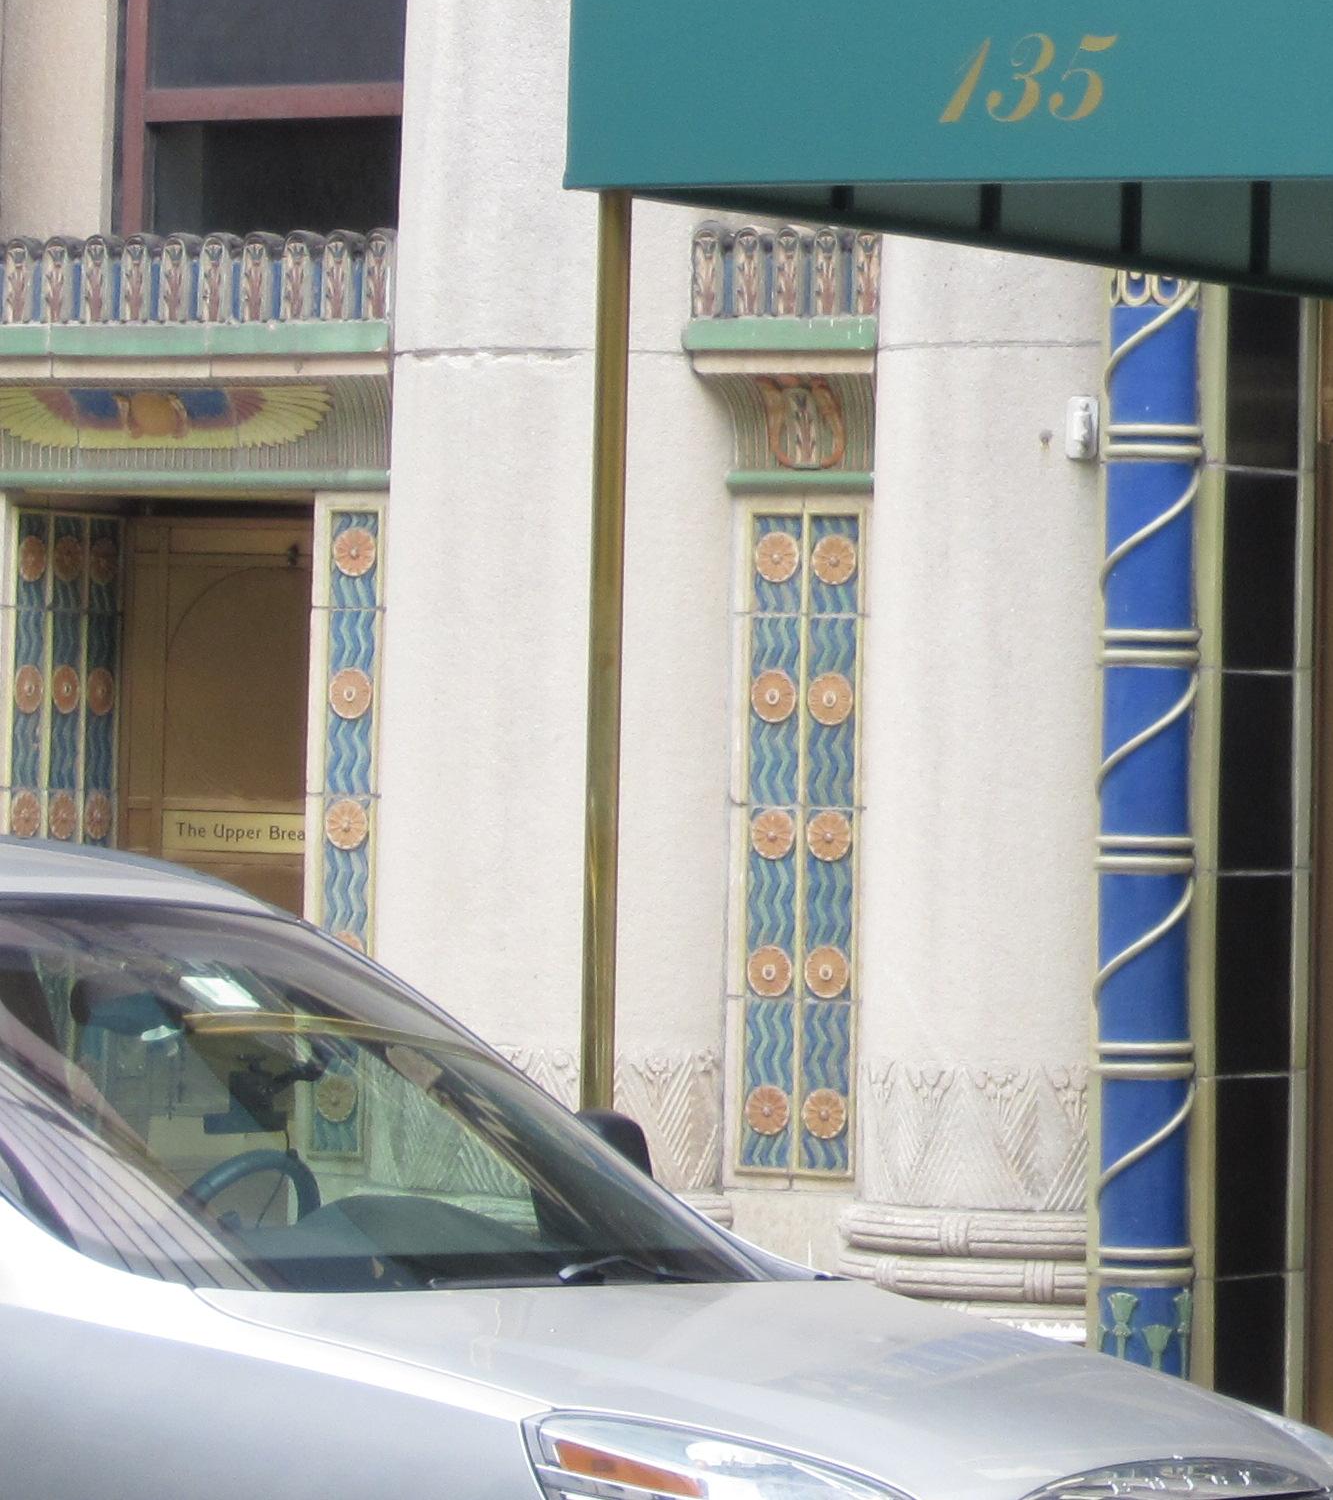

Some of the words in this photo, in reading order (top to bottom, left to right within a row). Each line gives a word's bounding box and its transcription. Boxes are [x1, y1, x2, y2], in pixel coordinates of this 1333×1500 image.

[938, 32, 1120, 124] 135
[175, 821, 206, 837] The
[213, 823, 262, 842] Upper
